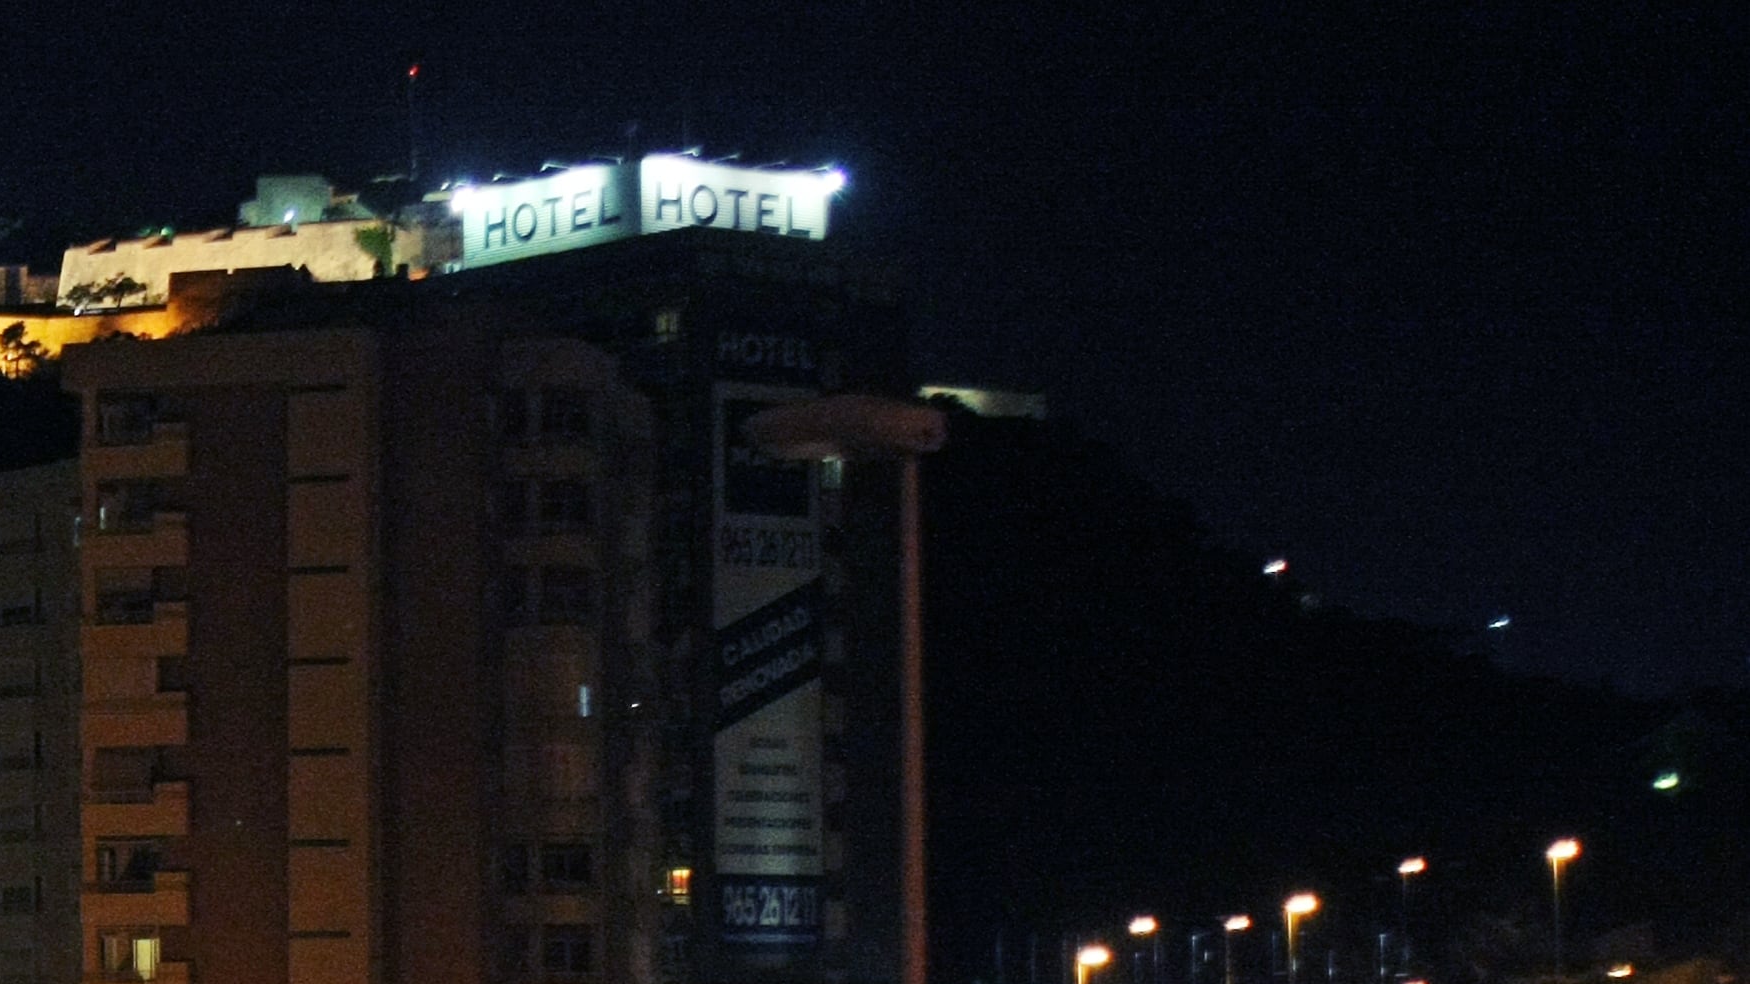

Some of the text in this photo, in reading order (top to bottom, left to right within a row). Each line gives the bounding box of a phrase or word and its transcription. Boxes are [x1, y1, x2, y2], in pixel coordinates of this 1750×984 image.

[484, 187, 621, 248] HOTEL
[655, 180, 811, 239] HOTEL
[717, 331, 815, 370] HOTEL
[758, 885, 780, 926] 26
